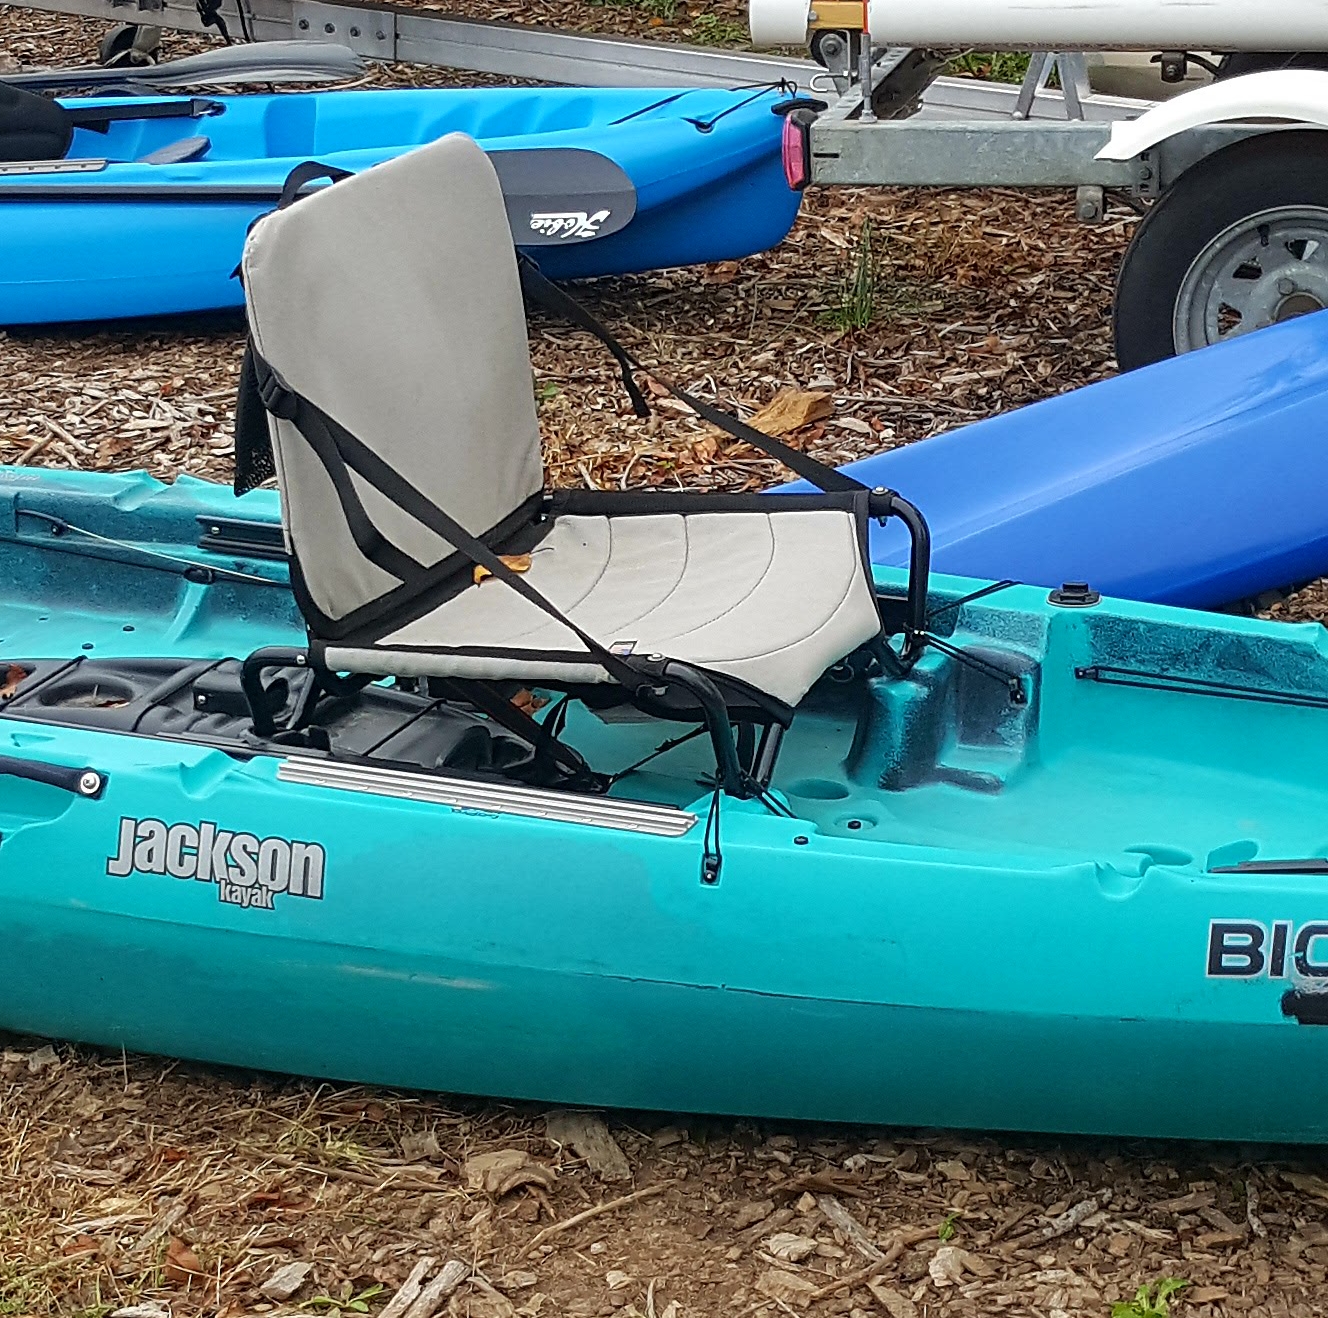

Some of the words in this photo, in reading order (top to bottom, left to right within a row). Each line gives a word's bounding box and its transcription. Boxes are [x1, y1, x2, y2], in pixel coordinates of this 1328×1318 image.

[530, 209, 611, 239] Hobie
[106, 816, 326, 900] Jackson
[219, 878, 275, 910] kayak
